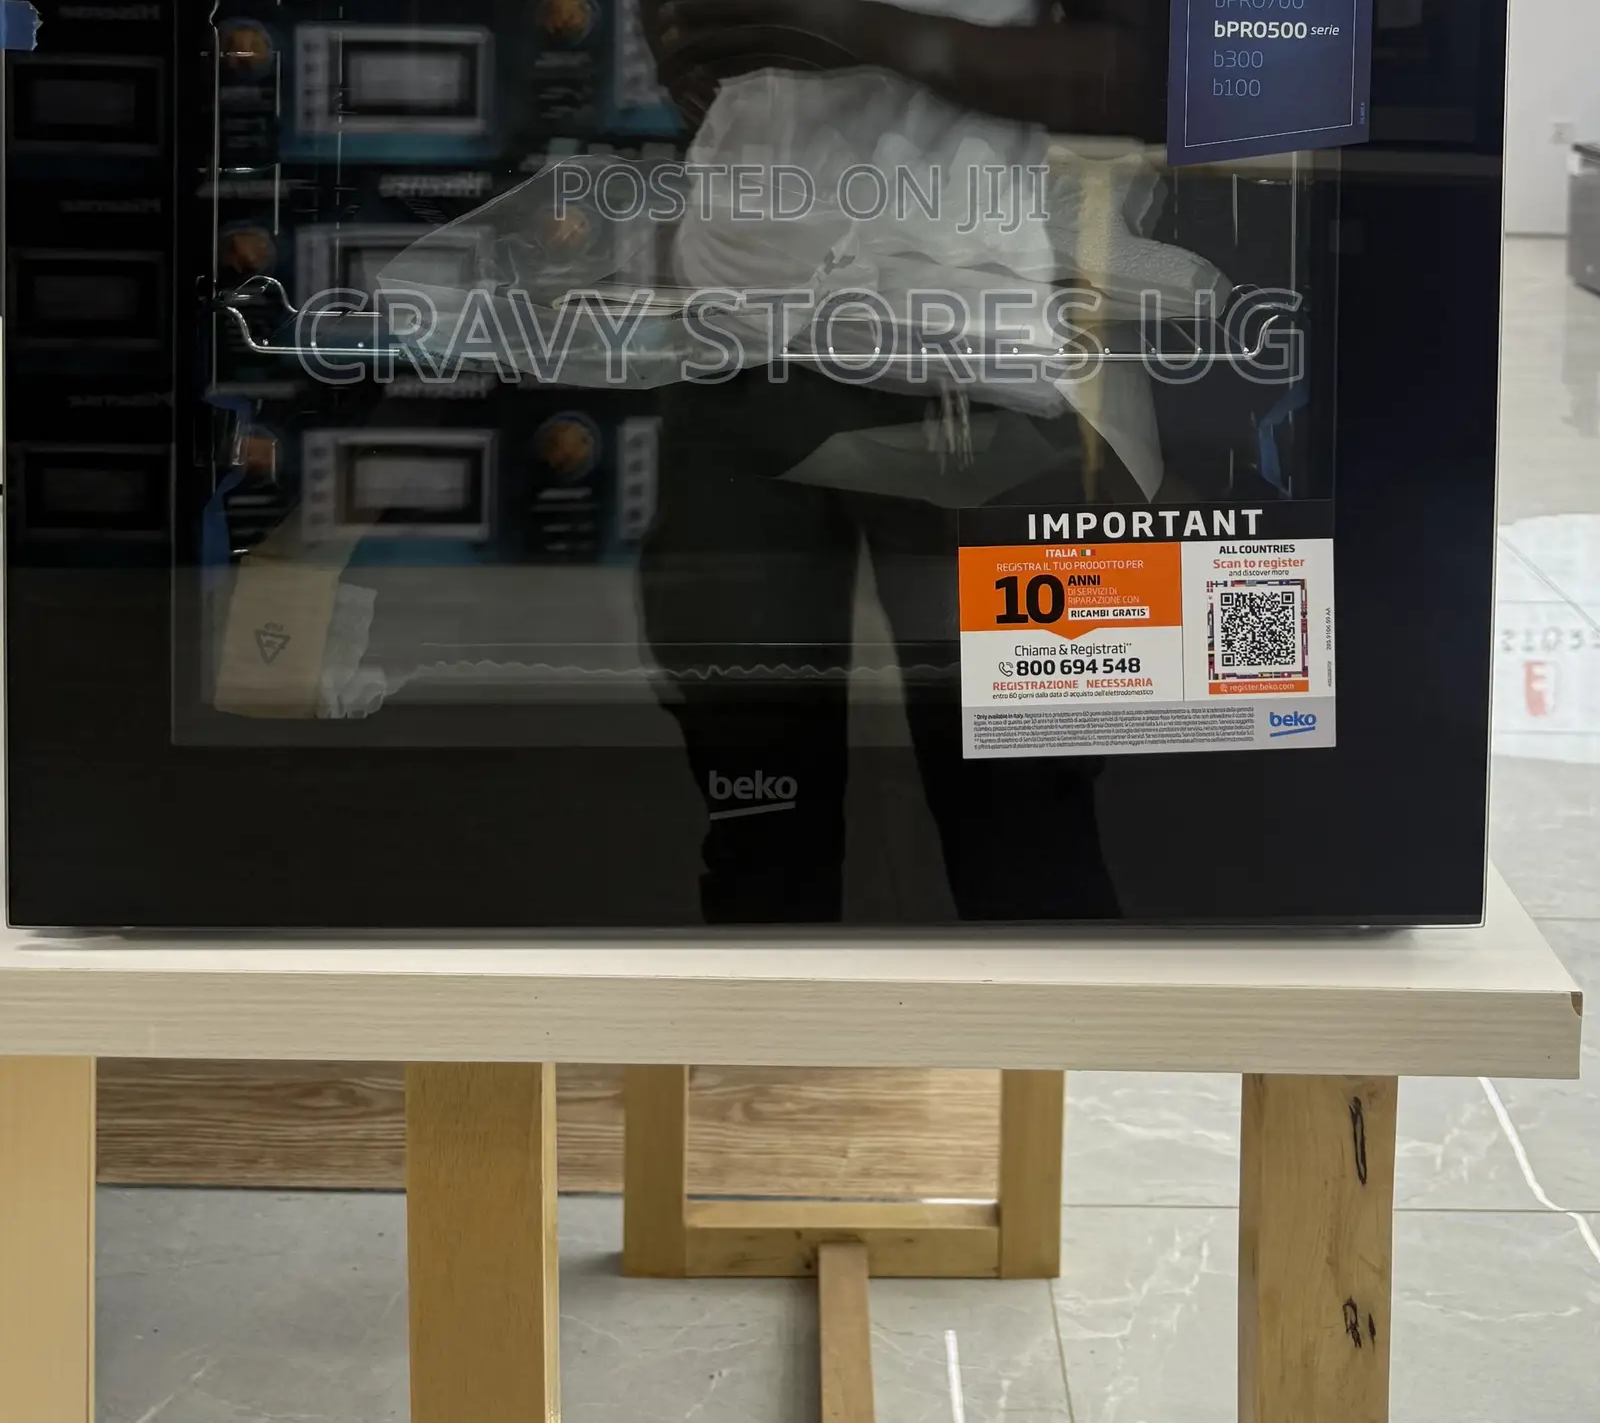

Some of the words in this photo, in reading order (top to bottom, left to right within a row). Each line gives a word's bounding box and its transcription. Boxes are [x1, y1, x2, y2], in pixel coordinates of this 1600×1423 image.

[1214, 20, 1308, 39] bPRO500
[1311, 24, 1340, 36] serie
[1213, 50, 1263, 68] b300
[1213, 79, 1261, 97] b100
[1028, 508, 1264, 541] IMPORTANT
[1045, 549, 1078, 558] ITALIA
[1219, 545, 1238, 554] ALL
[1239, 544, 1296, 554] COUNTRIES
[996, 562, 1042, 572] REGISTRA
[1043, 562, 1051, 570] IL
[1053, 561, 1073, 570] TUO
[1074, 560, 1125, 570] PRODOTTO
[1126, 559, 1144, 569] PER
[1213, 559, 1241, 569] Scan
[1244, 559, 1256, 568] to
[1258, 558, 1305, 570] register
[1068, 575, 1101, 586] ANNI
[1068, 588, 1076, 596] DI
[1077, 587, 1108, 596] SERVIZI
[1109, 587, 1117, 595] DI
[995, 574, 1065, 624] 10
[1068, 596, 1121, 605] RIPARAZIONE
[1122, 595, 1140, 604] CON
[1070, 609, 1109, 618] RICAMBI
[1014, 645, 1056, 657] Chiama
[1058, 644, 1068, 655] &
[1016, 660, 1056, 676] 800
[1060, 658, 1098, 675] 694
[1102, 657, 1141, 674] 548
[992, 680, 1078, 691] REGISTRAZIONE
[1086, 678, 1153, 689] NECESSARIA
[1018, 692, 1034, 700] giorni
[1269, 711, 1317, 727] beko
[709, 770, 798, 800] beko
